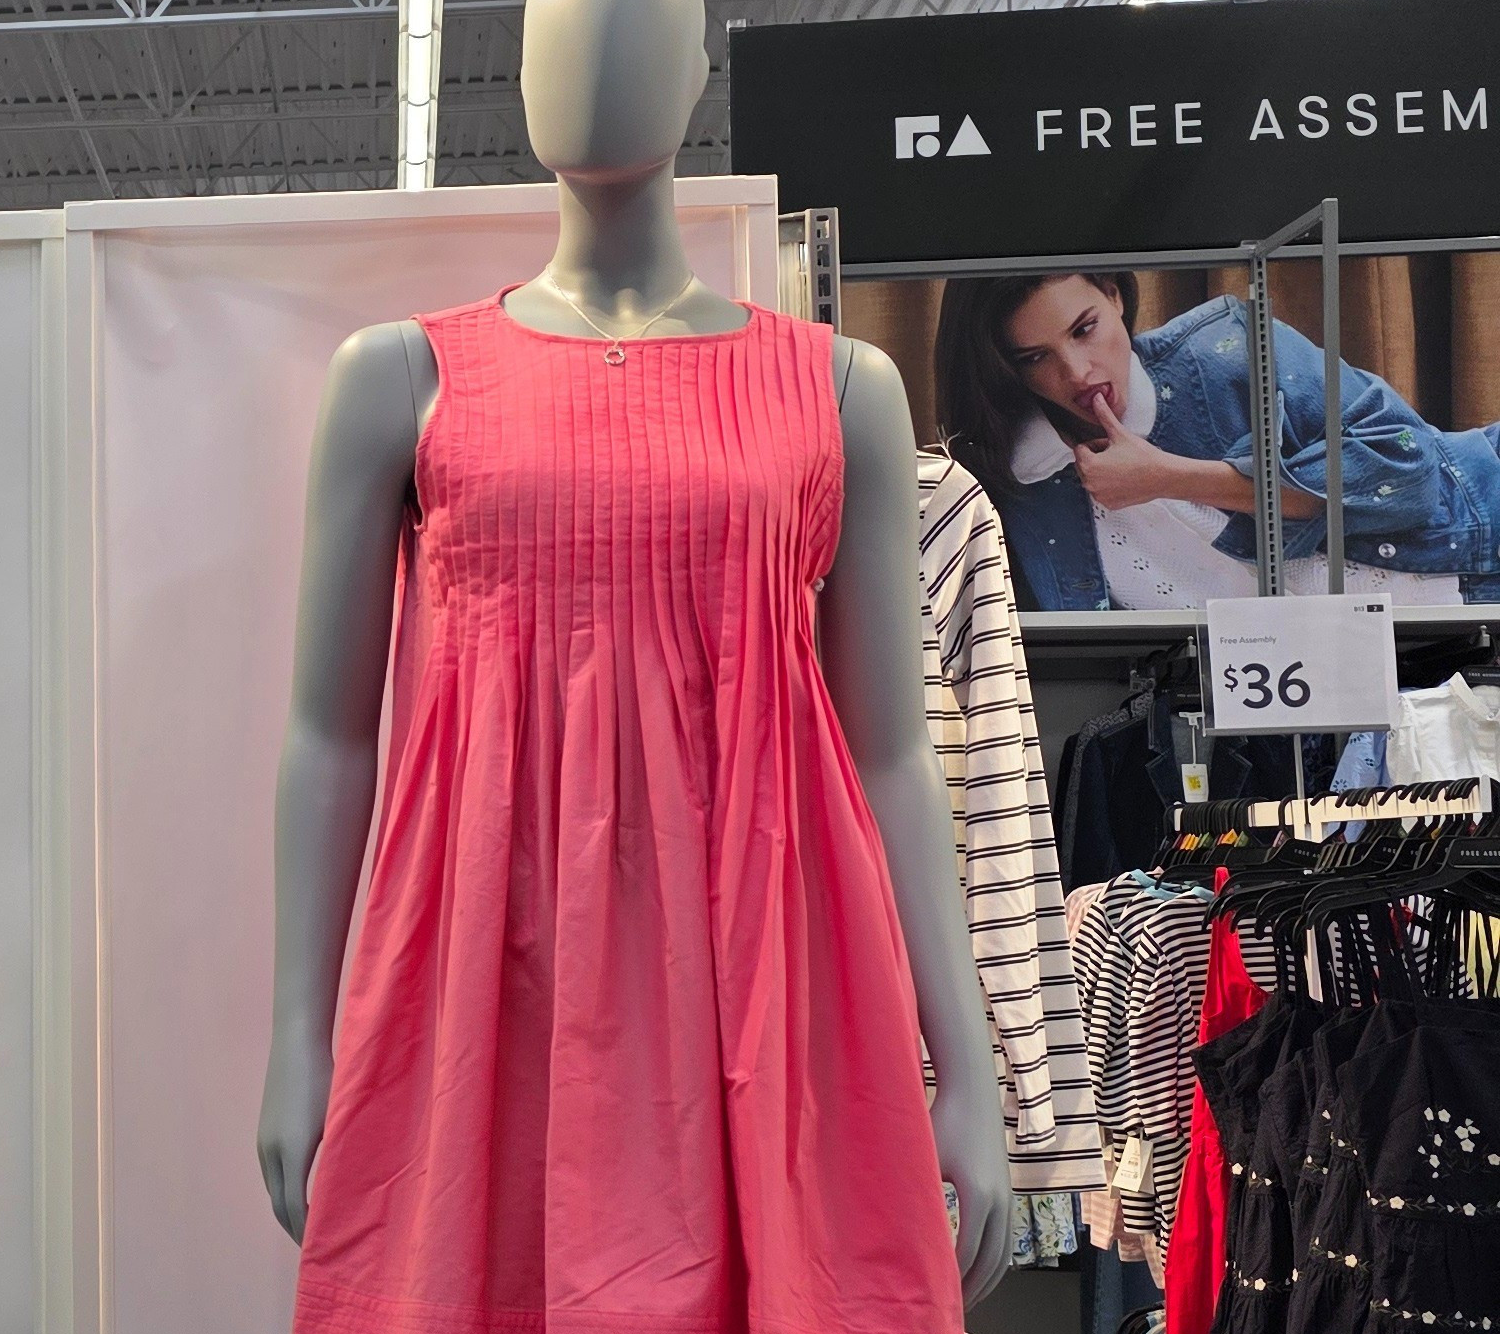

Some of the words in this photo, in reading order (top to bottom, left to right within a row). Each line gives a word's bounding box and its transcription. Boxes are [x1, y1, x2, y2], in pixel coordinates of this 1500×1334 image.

[1036, 101, 1203, 151] FREE
[1249, 87, 1488, 140] ASSEM
[1220, 636, 1238, 645] Free
[1239, 635, 1277, 645] Assembly
[1223, 660, 1311, 709] $36
